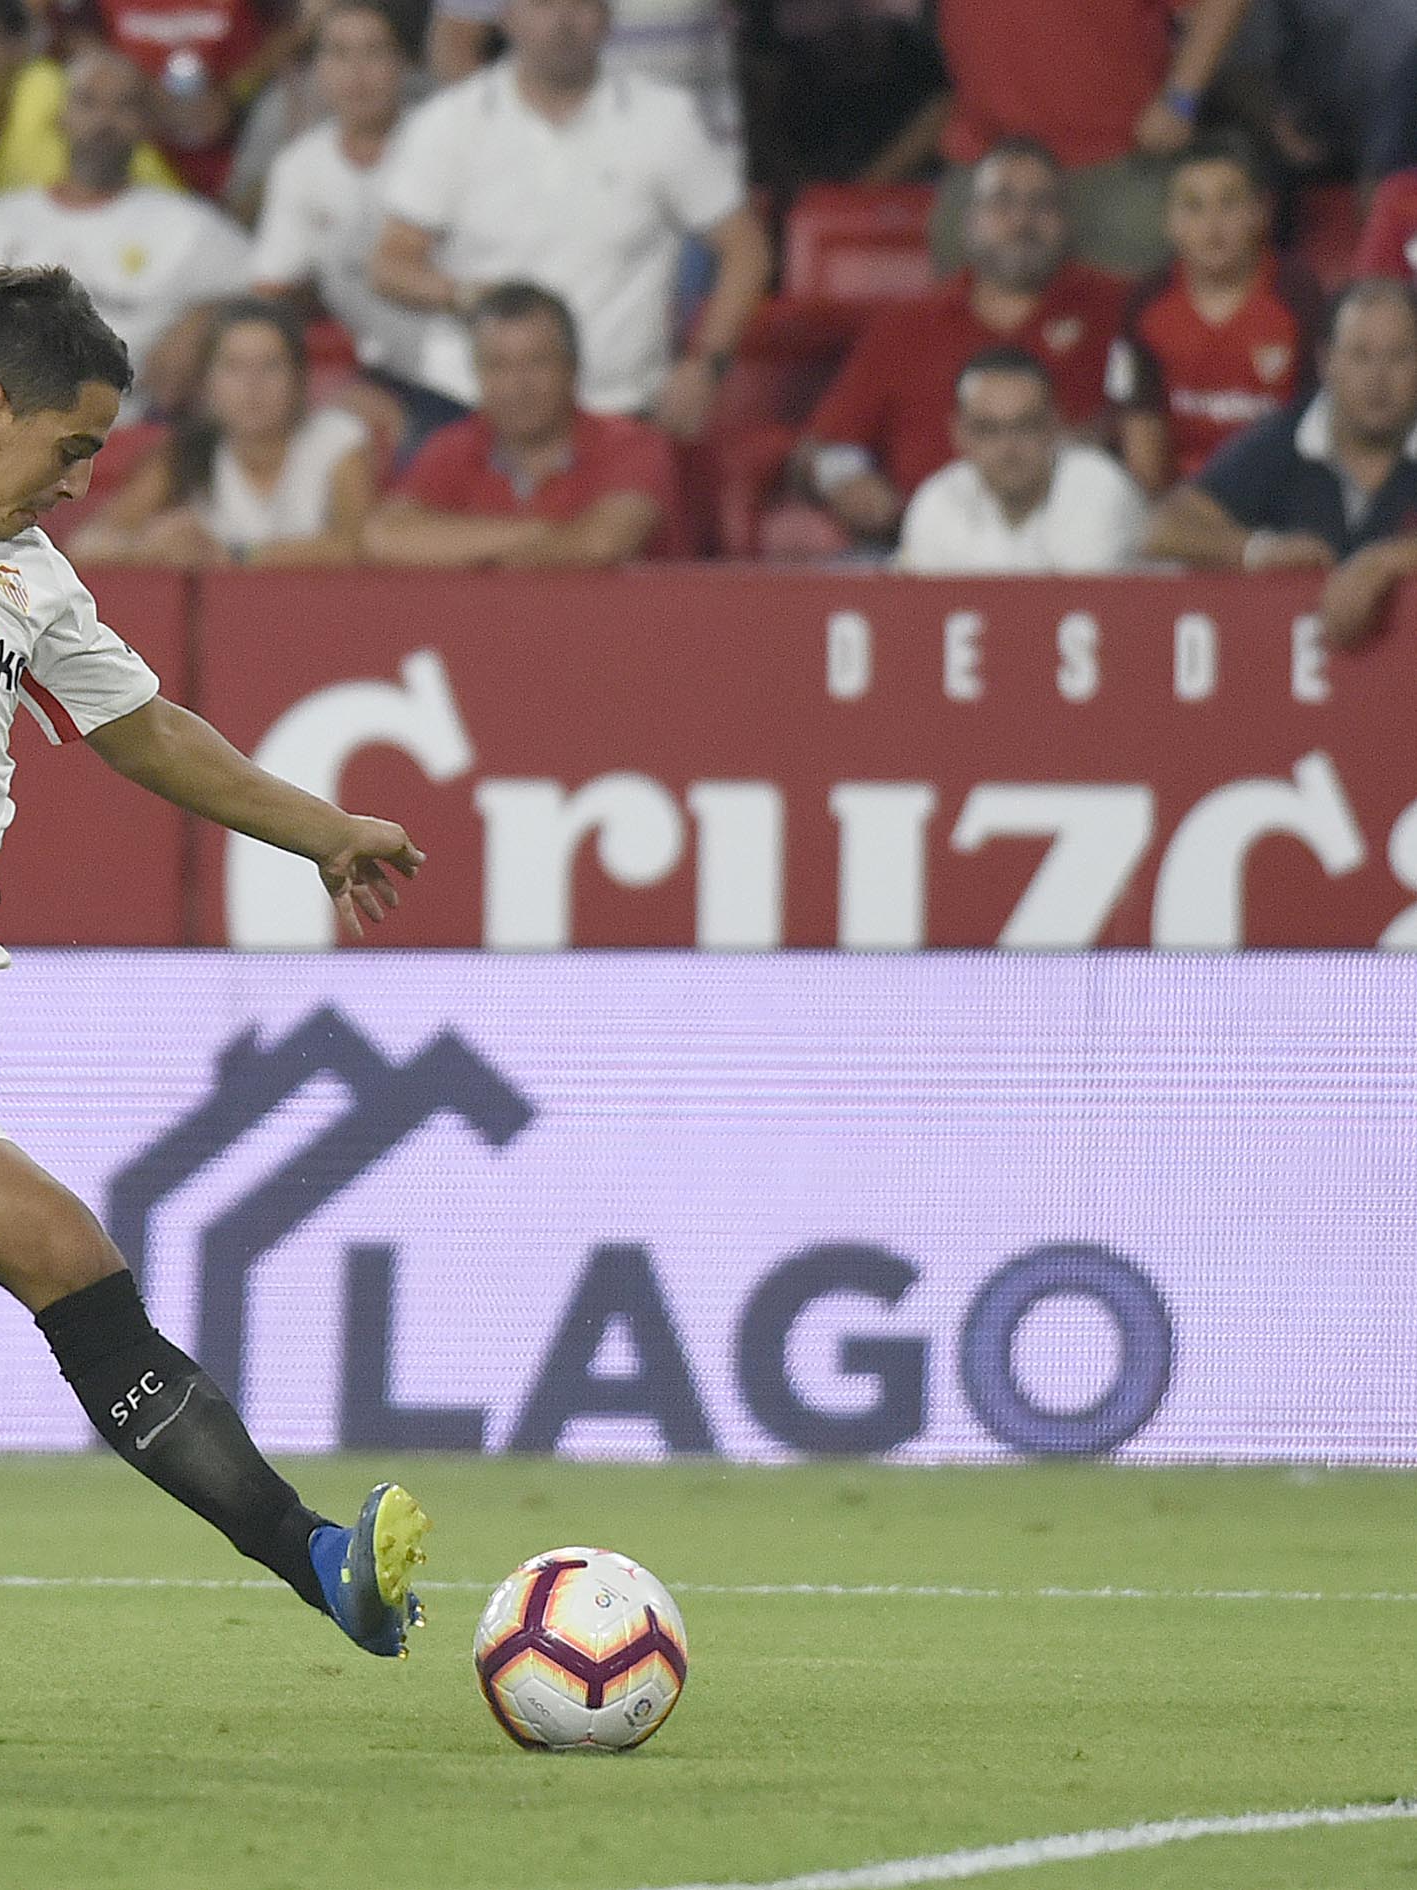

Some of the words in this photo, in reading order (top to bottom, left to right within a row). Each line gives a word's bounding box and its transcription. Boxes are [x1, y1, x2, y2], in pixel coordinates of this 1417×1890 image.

[826, 609, 1334, 704] DESDE
[223, 643, 1417, 951] Cruzc
[110, 1370, 164, 1427] SFC
[337, 1240, 1175, 1456] LAGO
